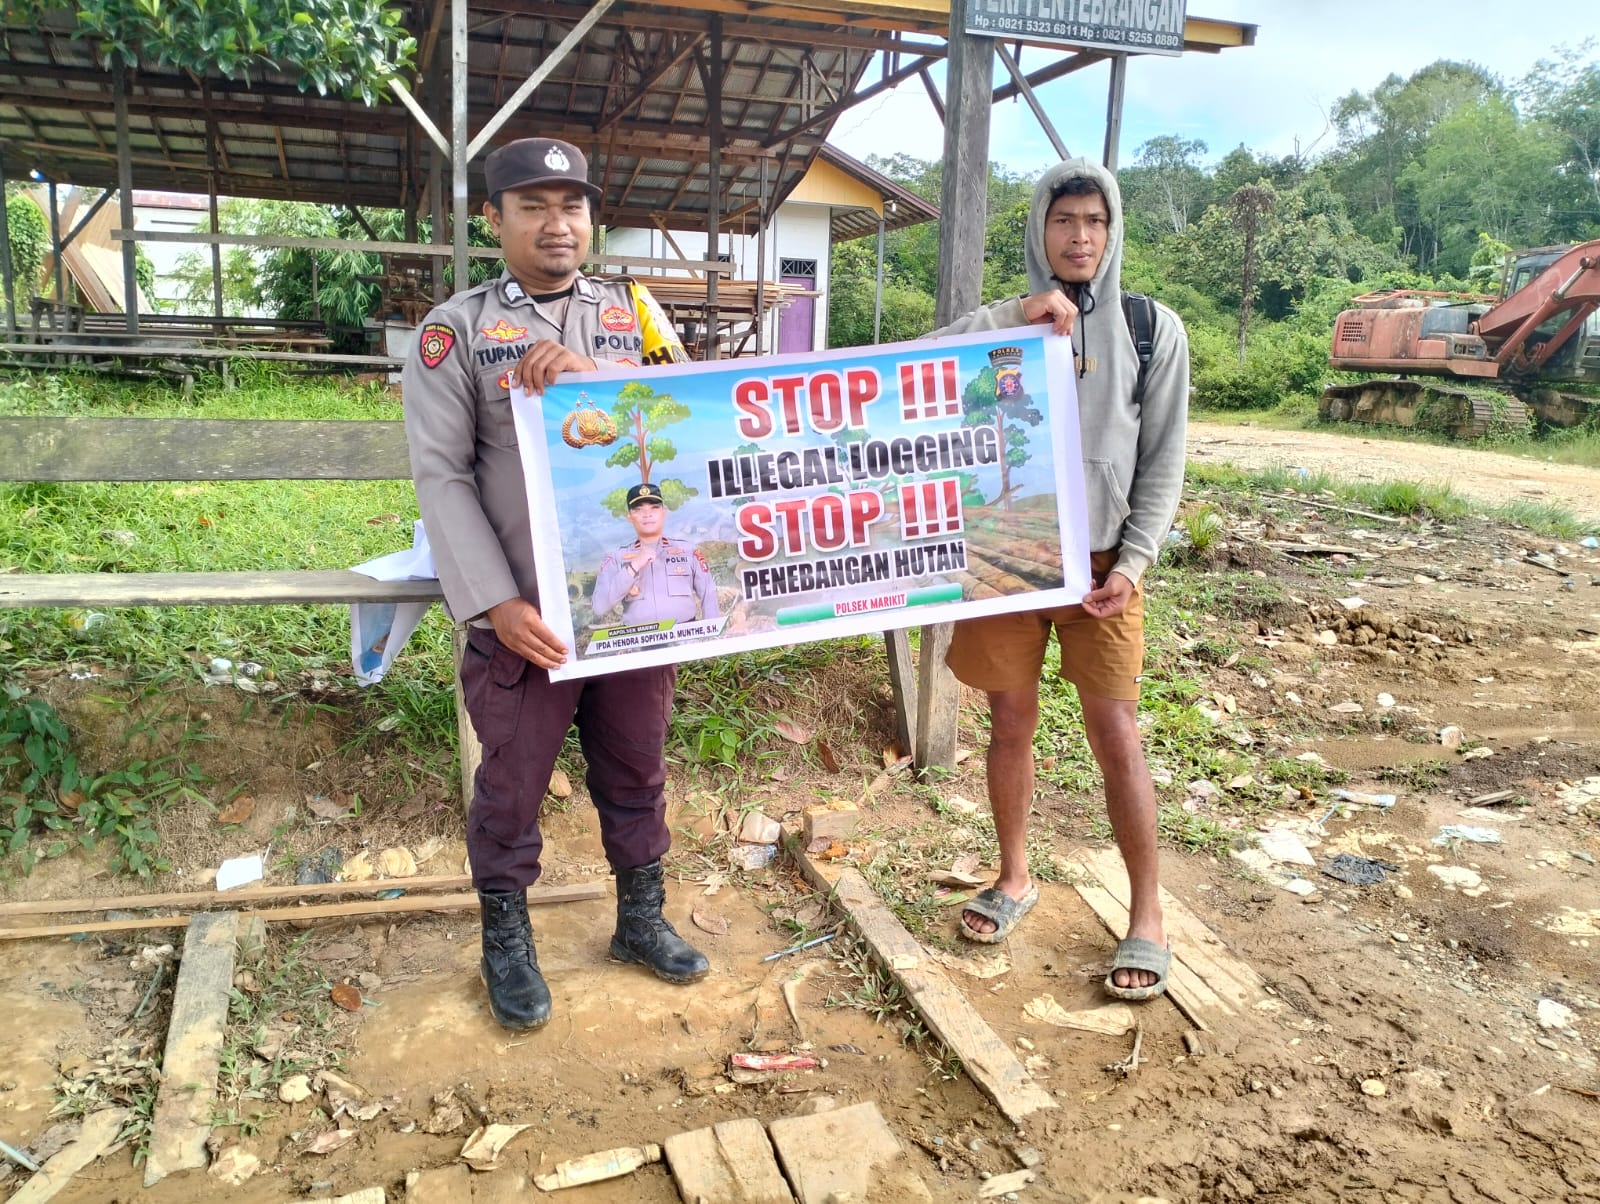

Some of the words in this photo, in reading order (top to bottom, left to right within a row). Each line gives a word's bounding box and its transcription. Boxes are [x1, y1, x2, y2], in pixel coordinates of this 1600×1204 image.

[975, 14, 989, 28] Hp
[998, 17, 1023, 30] 0821
[1026, 20, 1051, 33] 5323
[1053, 23, 1078, 36] 6811
[1080, 26, 1094, 39] Hp
[1102, 29, 1126, 41] 0821
[1128, 31, 1152, 44] 5255
[1154, 34, 1179, 46] 0880
[476, 343, 534, 367] TUPAN
[594, 334, 642, 352] POLR
[735, 369, 878, 439] STOP
[900, 359, 960, 420] !!!
[708, 446, 844, 498] ILLEGAL
[849, 428, 998, 482] LOGGING
[738, 491, 881, 559] STOP
[901, 480, 961, 538] !!!
[743, 551, 889, 600] PENEBANGAN
[894, 541, 966, 579] HUTAN
[835, 598, 869, 616] POLSEK
[870, 593, 906, 612] MARIKIT
[596, 640, 612, 651] IPDA
[612, 637, 639, 648] HENDRA
[640, 633, 668, 645] SOPIYAN
[676, 627, 706, 638] MUNTHE,
[706, 625, 719, 634] S.H.
